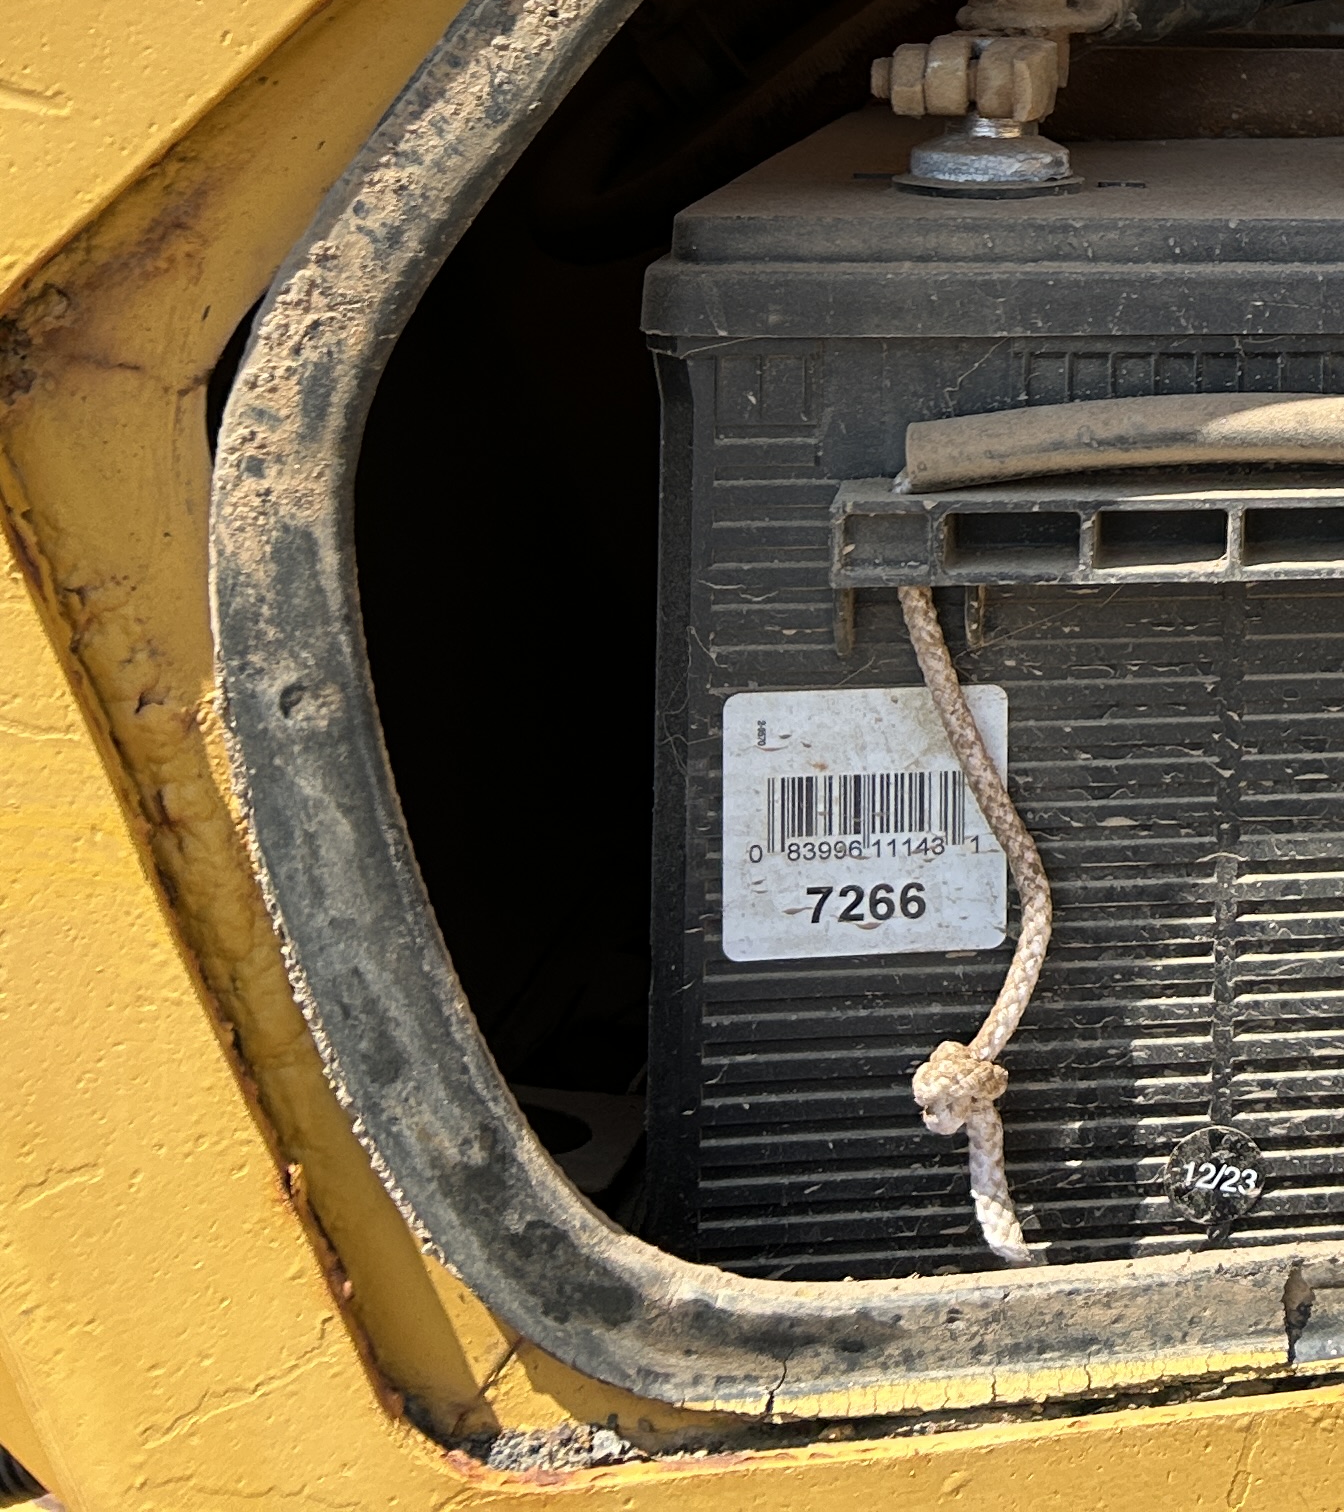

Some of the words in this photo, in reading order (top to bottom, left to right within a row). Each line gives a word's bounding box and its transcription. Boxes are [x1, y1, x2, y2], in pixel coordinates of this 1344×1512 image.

[749, 844, 763, 863] 0
[787, 840, 863, 862] 83996
[871, 837, 946, 858] 11143
[970, 837, 981, 854] 1
[806, 882, 927, 924] 7266
[1182, 1161, 1258, 1195] 12/23
